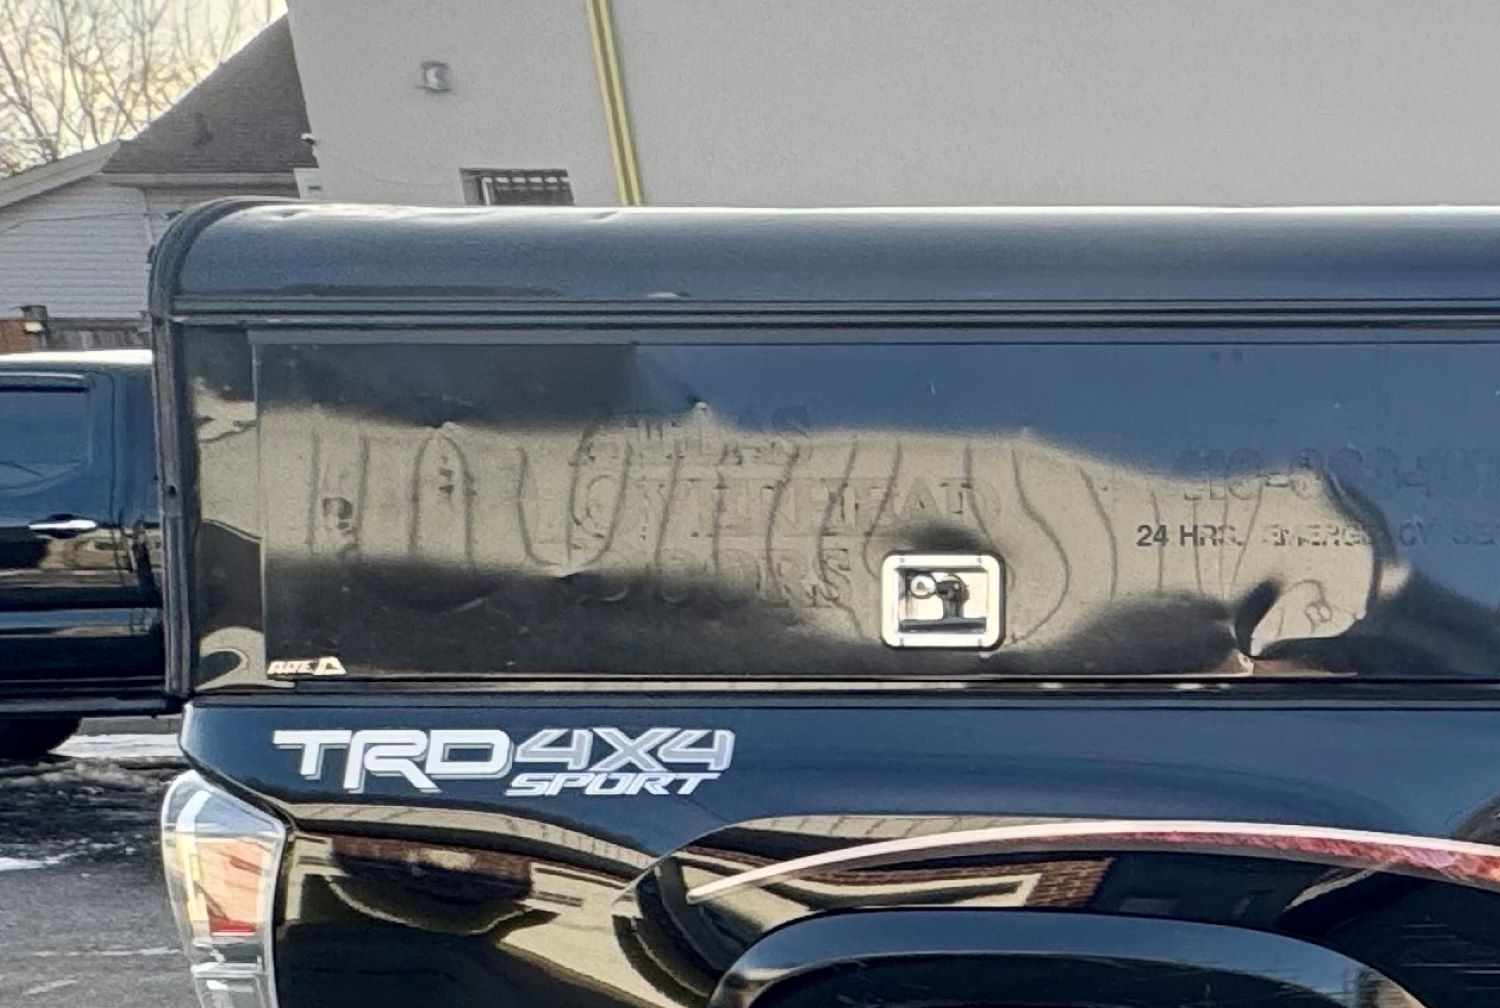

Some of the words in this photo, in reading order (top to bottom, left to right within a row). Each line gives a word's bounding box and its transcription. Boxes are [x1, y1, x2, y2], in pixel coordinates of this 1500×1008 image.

[1136, 524, 1169, 547] 24
[1262, 523, 1434, 547] EMERGECY
[273, 729, 515, 794] TRD
[505, 772, 721, 797] SPORT
